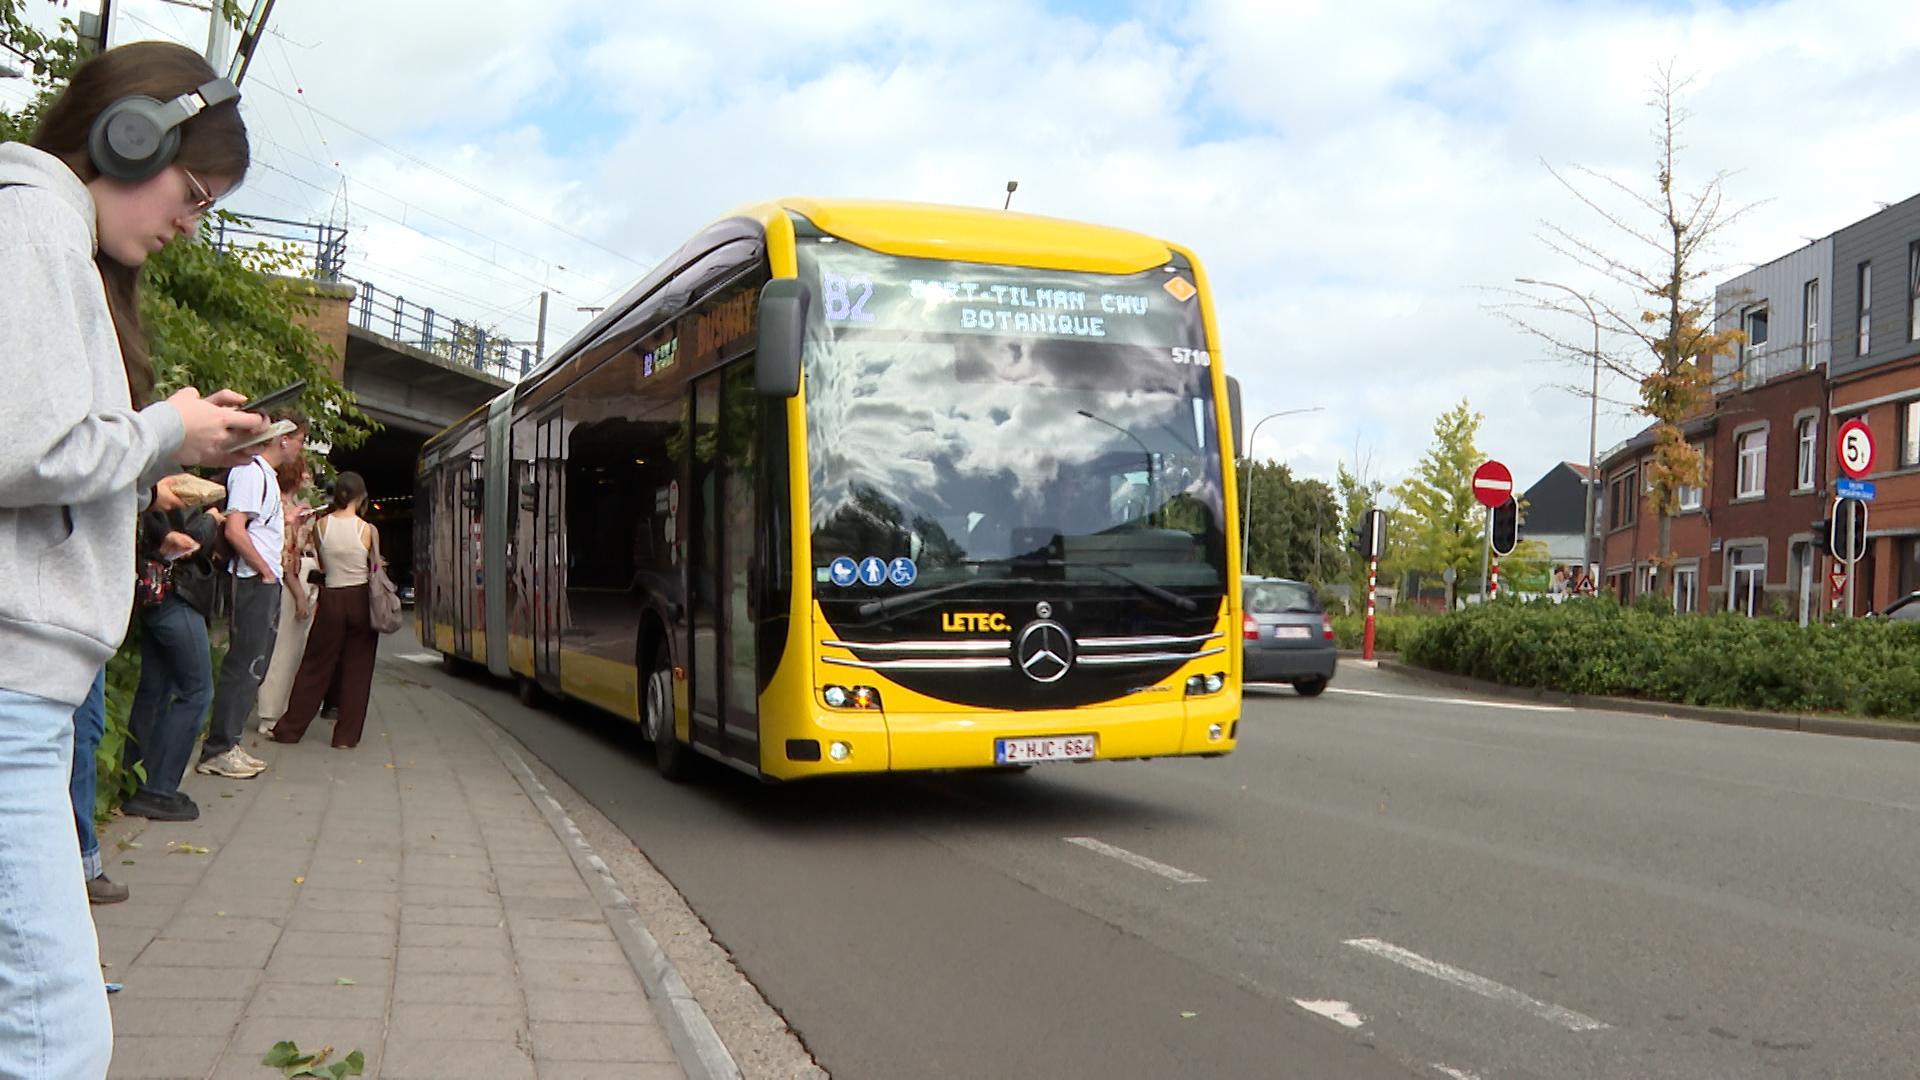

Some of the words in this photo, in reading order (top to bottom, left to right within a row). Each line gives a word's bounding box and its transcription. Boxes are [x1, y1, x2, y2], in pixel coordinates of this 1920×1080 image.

[824, 272, 874, 321] B2
[909, 278, 1086, 311] RT-TILMAN
[1101, 293, 1149, 316] CHU
[961, 308, 1106, 337] BOTANIQUE
